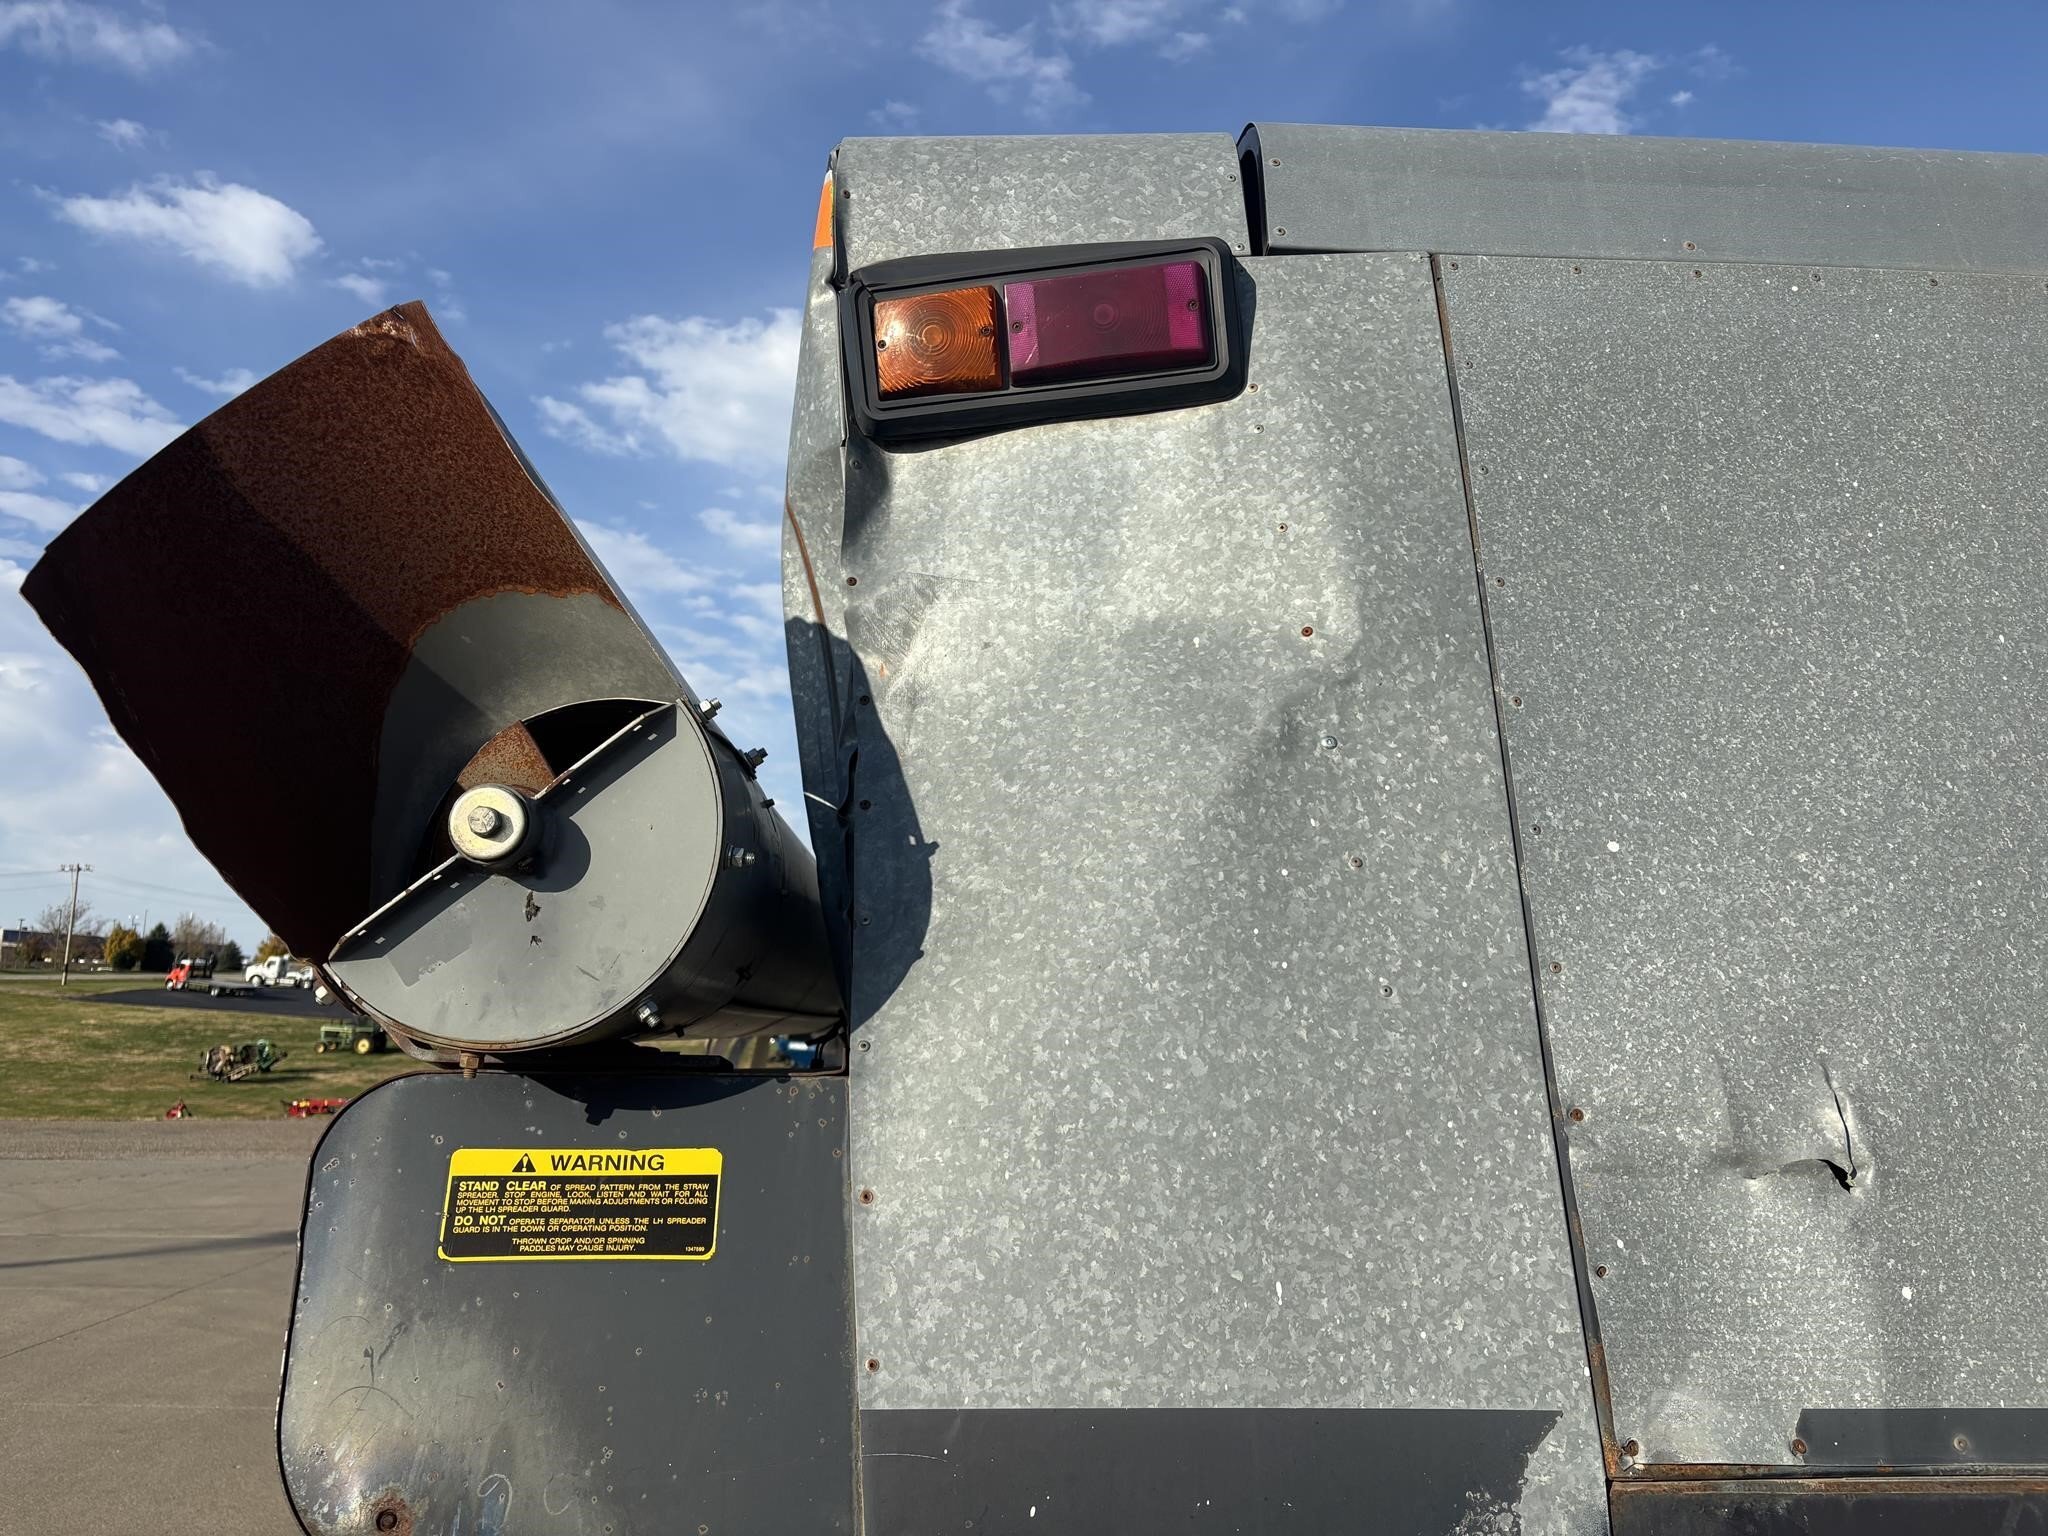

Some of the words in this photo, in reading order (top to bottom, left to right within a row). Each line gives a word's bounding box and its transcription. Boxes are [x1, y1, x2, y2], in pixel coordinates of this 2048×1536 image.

[551, 1154, 664, 1170] WARNING
[459, 1181, 499, 1190] STAND
[506, 1181, 546, 1190] CLEAR
[454, 1216, 473, 1225] DO
[480, 1216, 506, 1225] NOT
